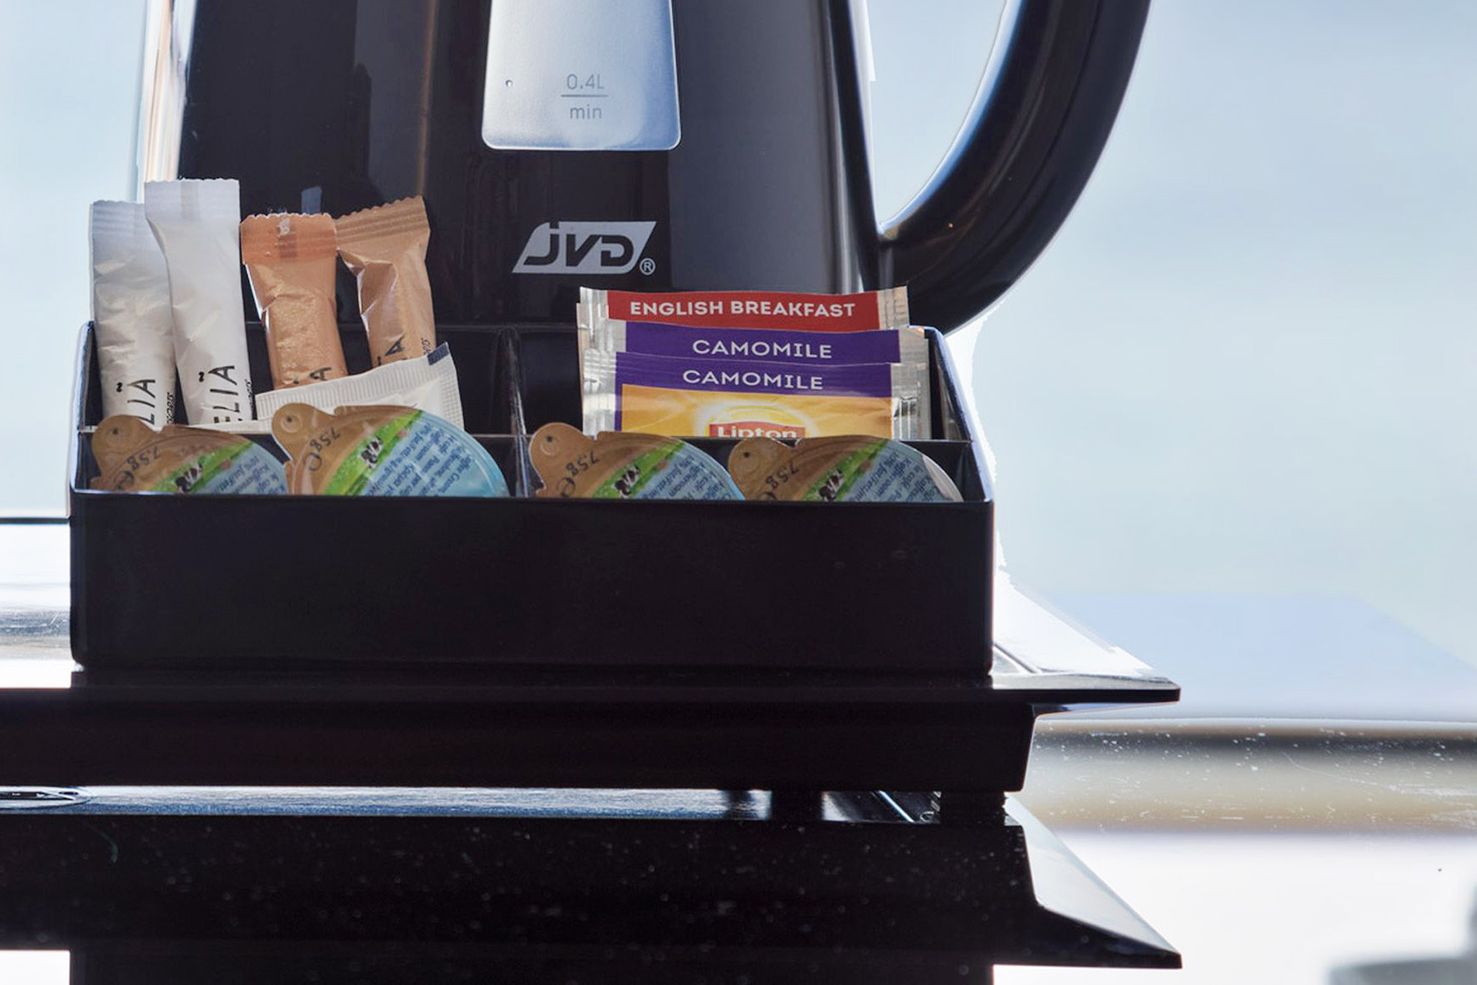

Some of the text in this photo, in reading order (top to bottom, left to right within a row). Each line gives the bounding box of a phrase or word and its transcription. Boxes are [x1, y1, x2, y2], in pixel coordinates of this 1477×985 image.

[566, 73, 605, 90] 0.4L
[569, 104, 602, 119] min
[630, 300, 856, 318] ENGLISH BREAKFAST
[692, 338, 832, 359] CAMOMILE
[682, 369, 824, 391] CAMOMILE
